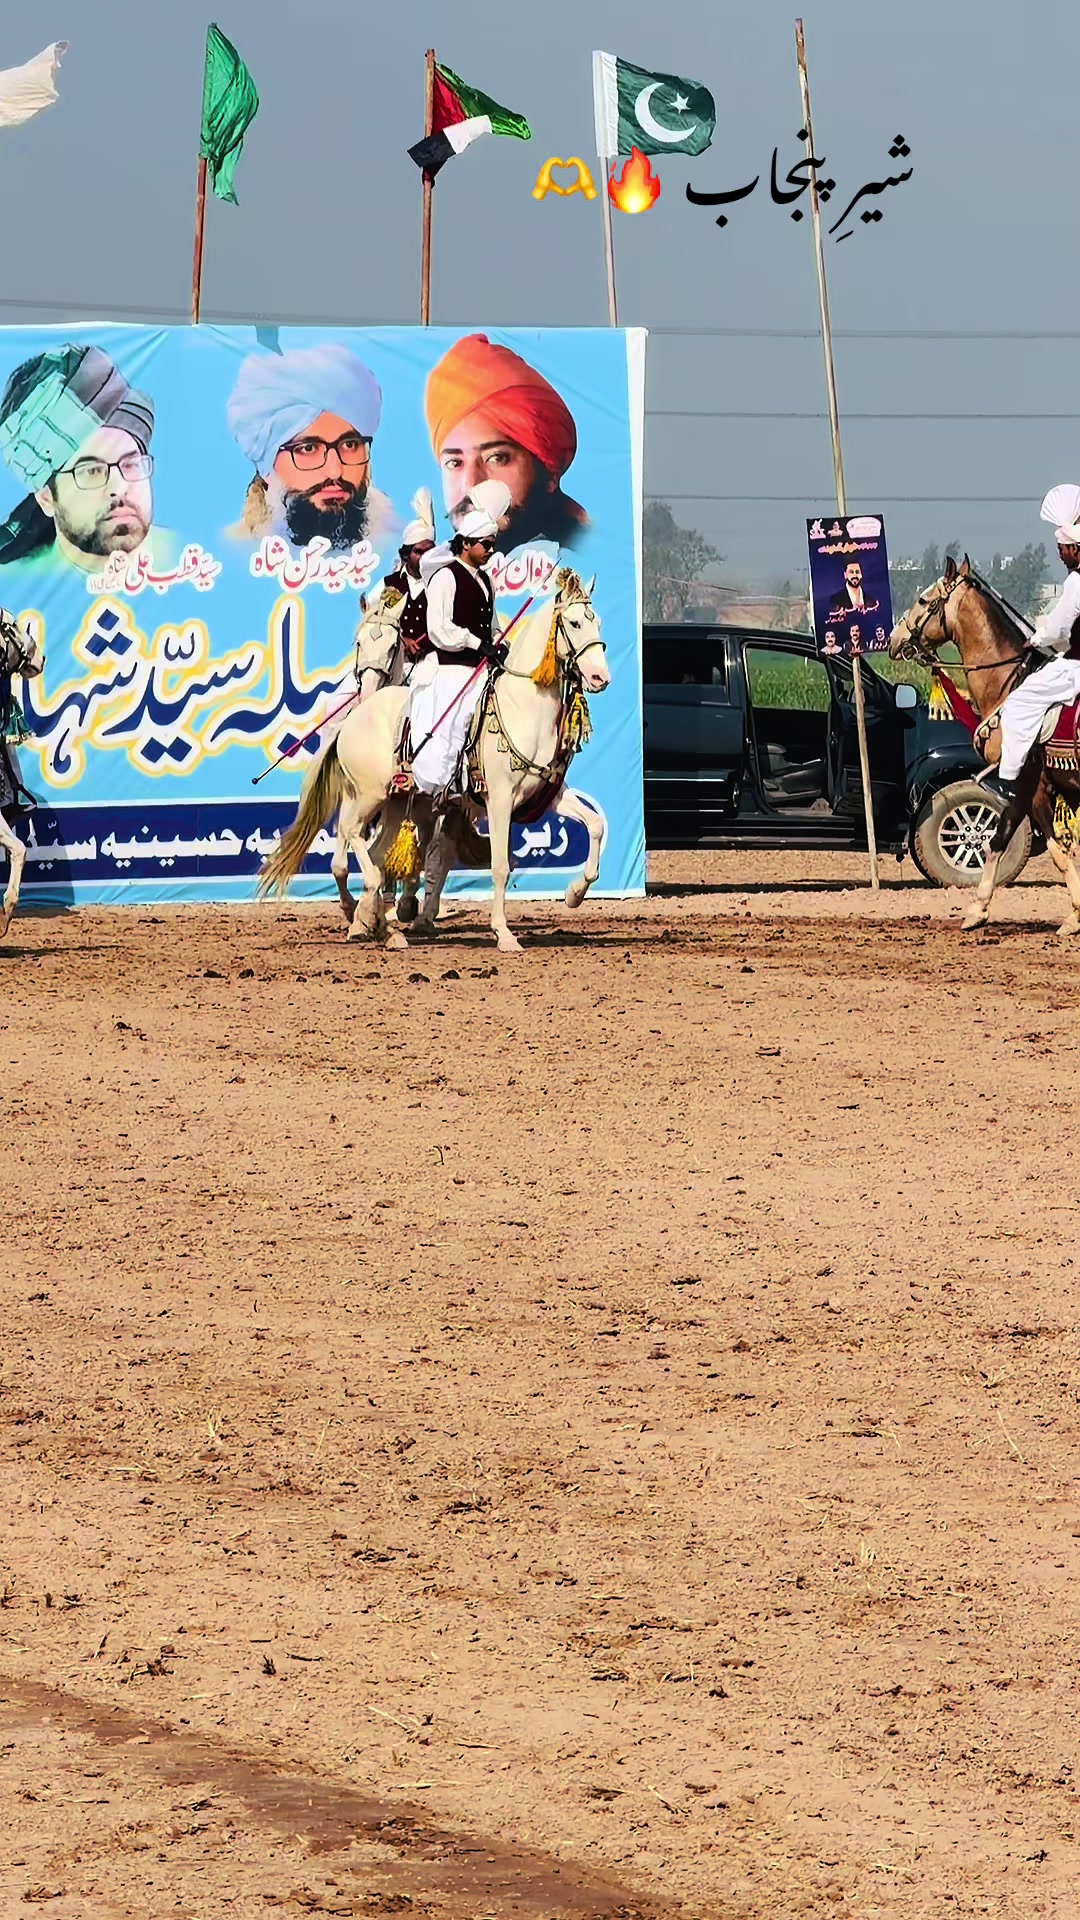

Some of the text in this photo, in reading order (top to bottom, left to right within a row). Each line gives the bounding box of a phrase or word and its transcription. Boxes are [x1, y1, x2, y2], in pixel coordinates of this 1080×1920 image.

[124, 552, 150, 591] علی
[146, 548, 199, 590] قطب
[255, 541, 287, 572] شاہ
[283, 541, 325, 589] حسن
[100, 825, 244, 868] حسینیہ
[512, 816, 569, 858] زیر
